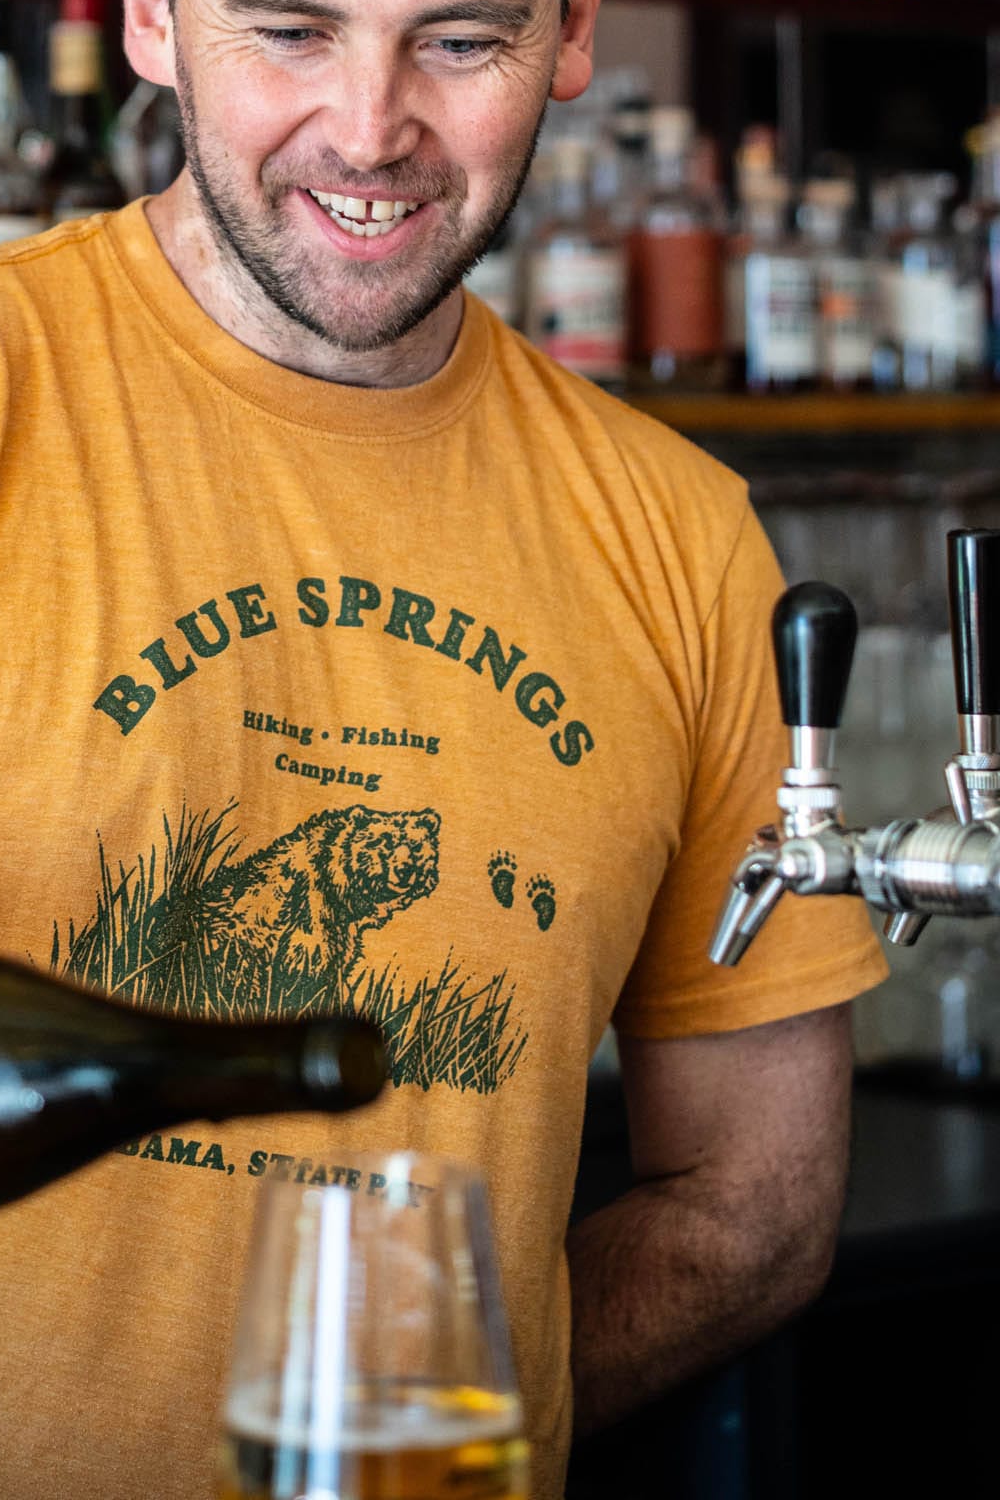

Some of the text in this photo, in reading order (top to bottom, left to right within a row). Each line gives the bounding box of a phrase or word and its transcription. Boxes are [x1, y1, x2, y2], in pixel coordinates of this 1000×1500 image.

[93, 575, 595, 767] BLUE SPRINGS
[243, 710, 441, 755] Hiking Fishing
[274, 753, 382, 793] Camping
[116, 1134, 236, 1176] BAMA,
